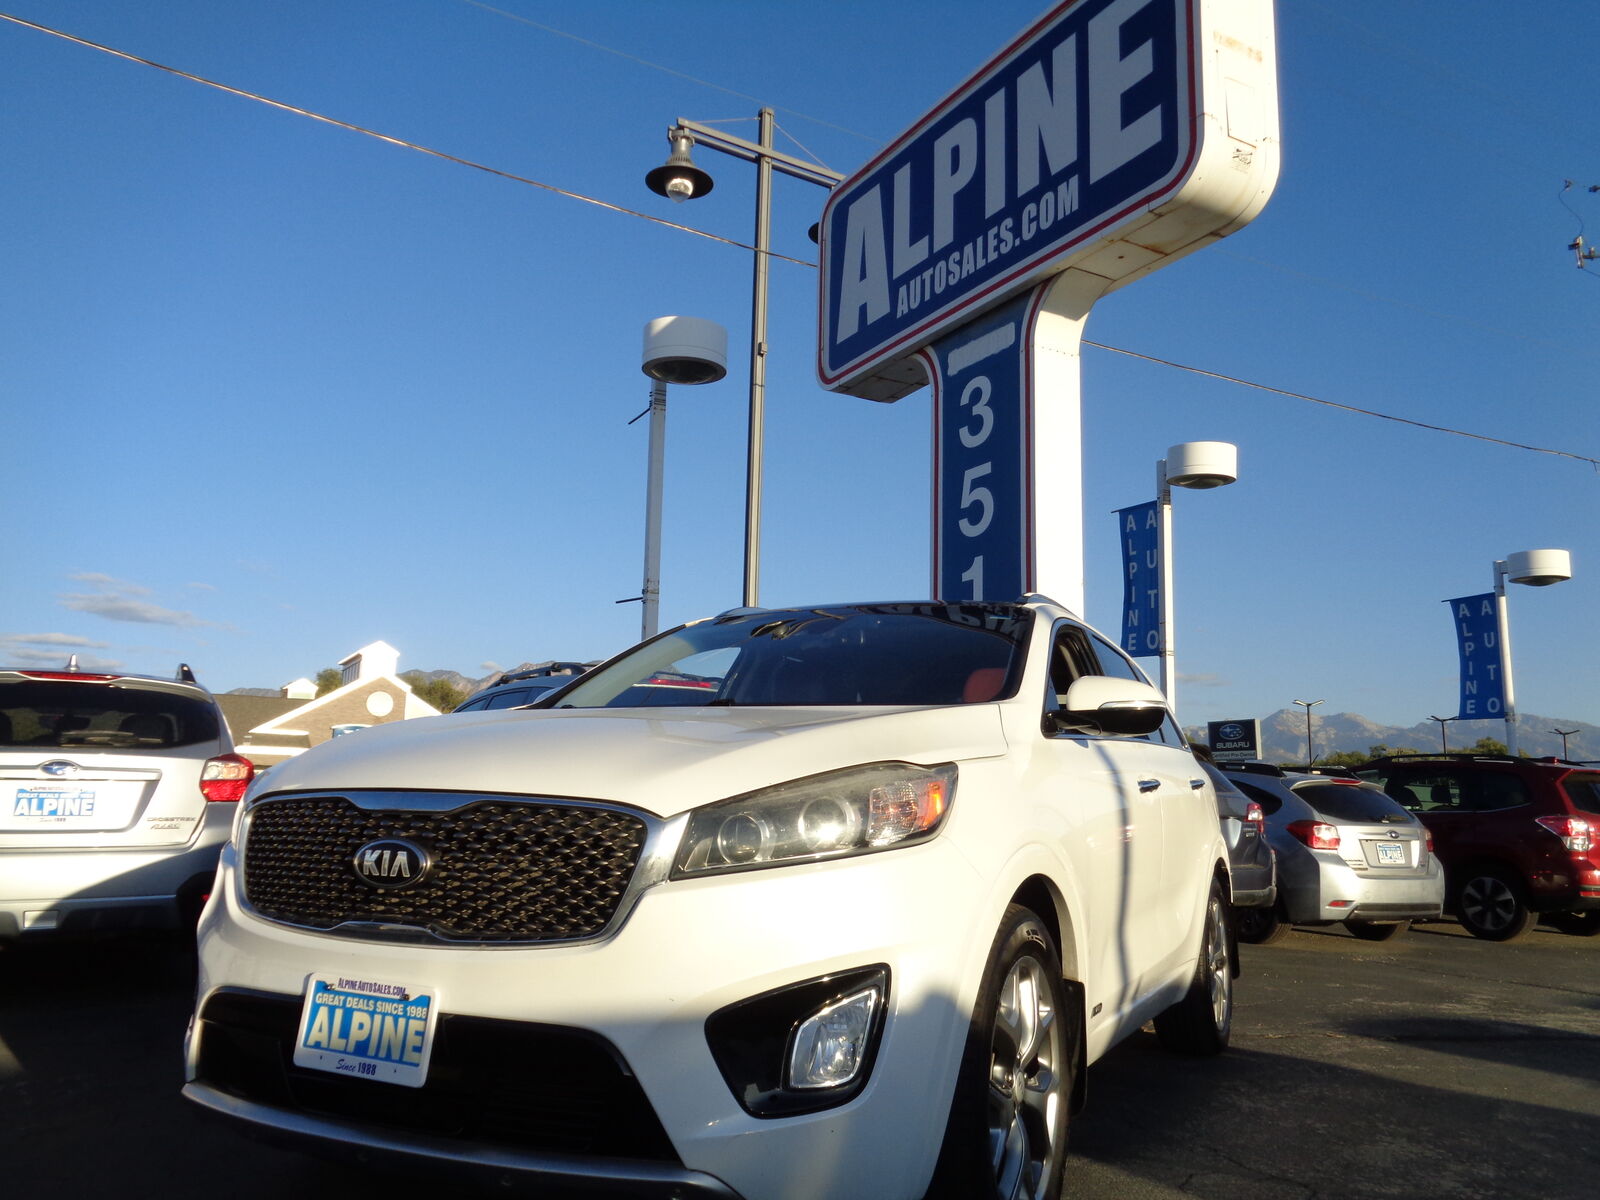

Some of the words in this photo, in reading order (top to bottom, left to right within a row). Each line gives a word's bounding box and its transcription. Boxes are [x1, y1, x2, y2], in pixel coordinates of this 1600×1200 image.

[837, 0, 1162, 344] ALPINE
[896, 175, 1079, 319] AUTOSALES.COM
[1126, 514, 1139, 651] ALPINE
[1145, 509, 1159, 650] AUTO
[1459, 603, 1477, 714] ALPINE
[1481, 600, 1500, 713] AUTO
[1216, 741, 1250, 749] SUBARU
[14, 798, 94, 816] ALPINE
[363, 850, 410, 877] KIA
[306, 1006, 426, 1064] ALPINE
[315, 992, 344, 1008] GREAT
[346, 996, 374, 1012] DEALS
[375, 1001, 404, 1015] SINCE
[406, 1005, 428, 1019] 1988
[336, 1058, 356, 1073] Since
[357, 1062, 377, 1076] 1988
